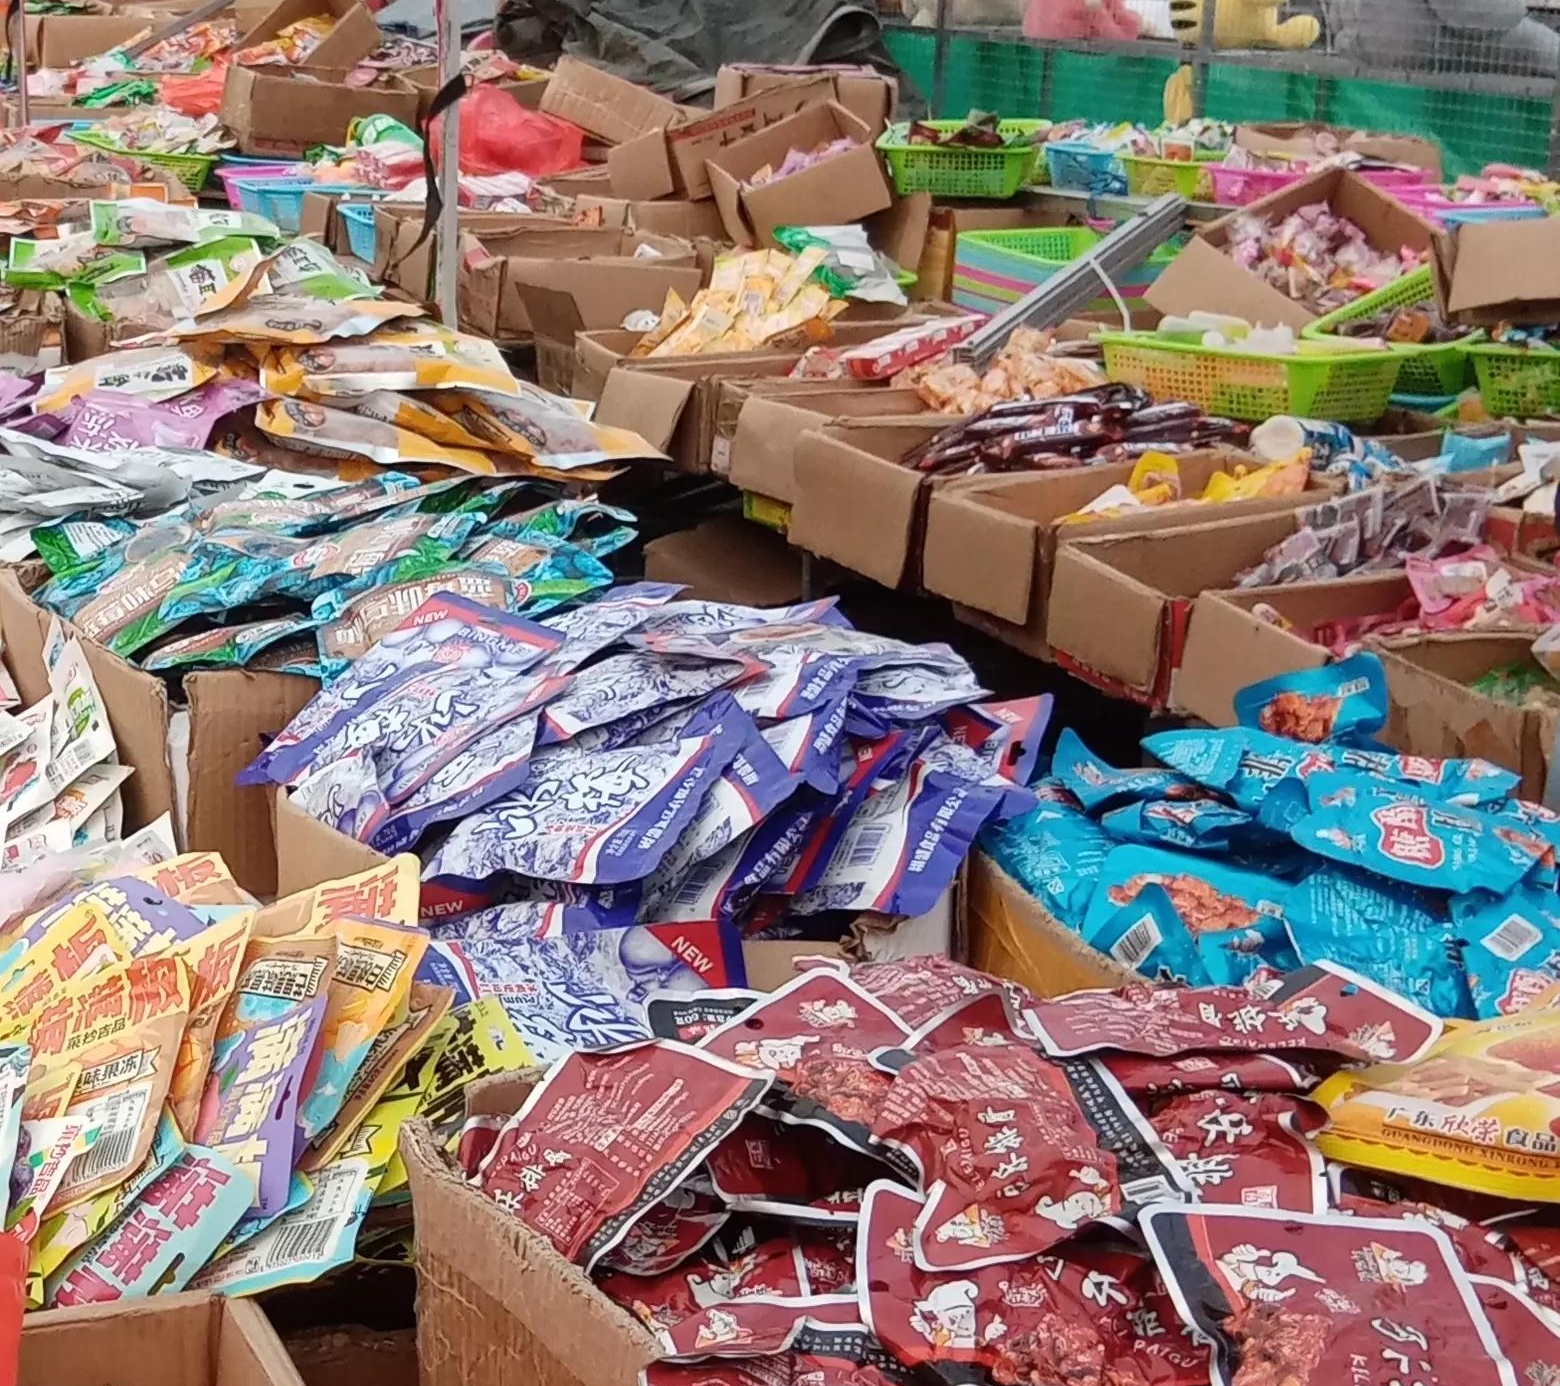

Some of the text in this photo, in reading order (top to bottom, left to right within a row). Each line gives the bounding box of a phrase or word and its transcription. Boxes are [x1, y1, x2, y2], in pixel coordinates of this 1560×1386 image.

[421, 898, 464, 919] NEW
[671, 932, 714, 978] NEW
[1386, 1104, 1559, 1154] 广东欣荣食品
